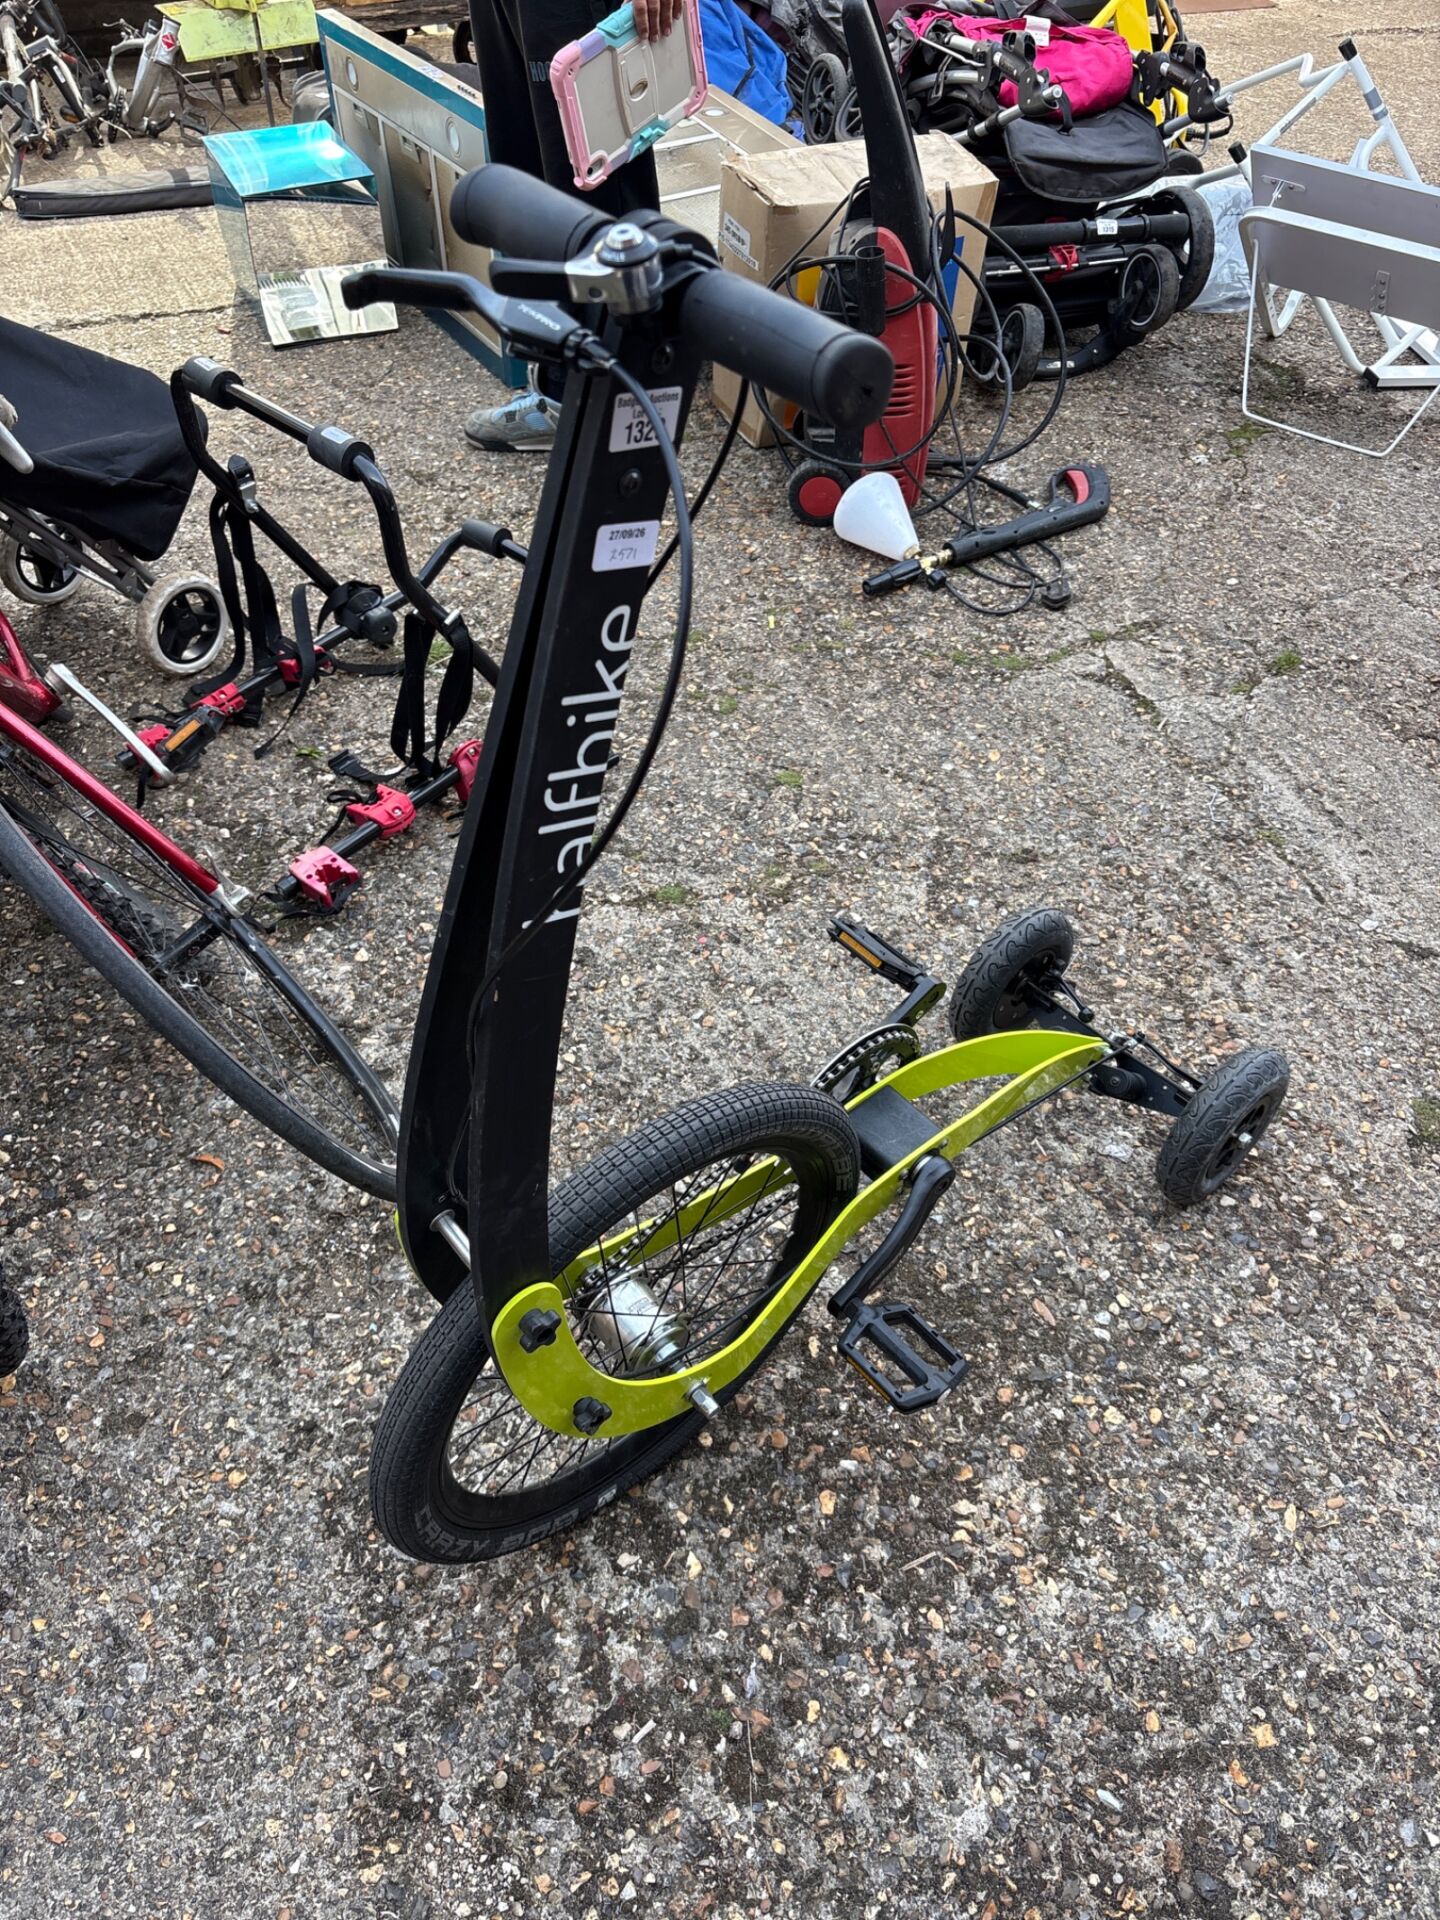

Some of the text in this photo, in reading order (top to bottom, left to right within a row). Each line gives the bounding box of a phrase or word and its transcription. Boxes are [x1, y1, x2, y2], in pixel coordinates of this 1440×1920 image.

[609, 527, 646, 541] 27/09/26
[521, 605, 635, 930] halfbike
[415, 1503, 579, 1558] CRAZY BOB
